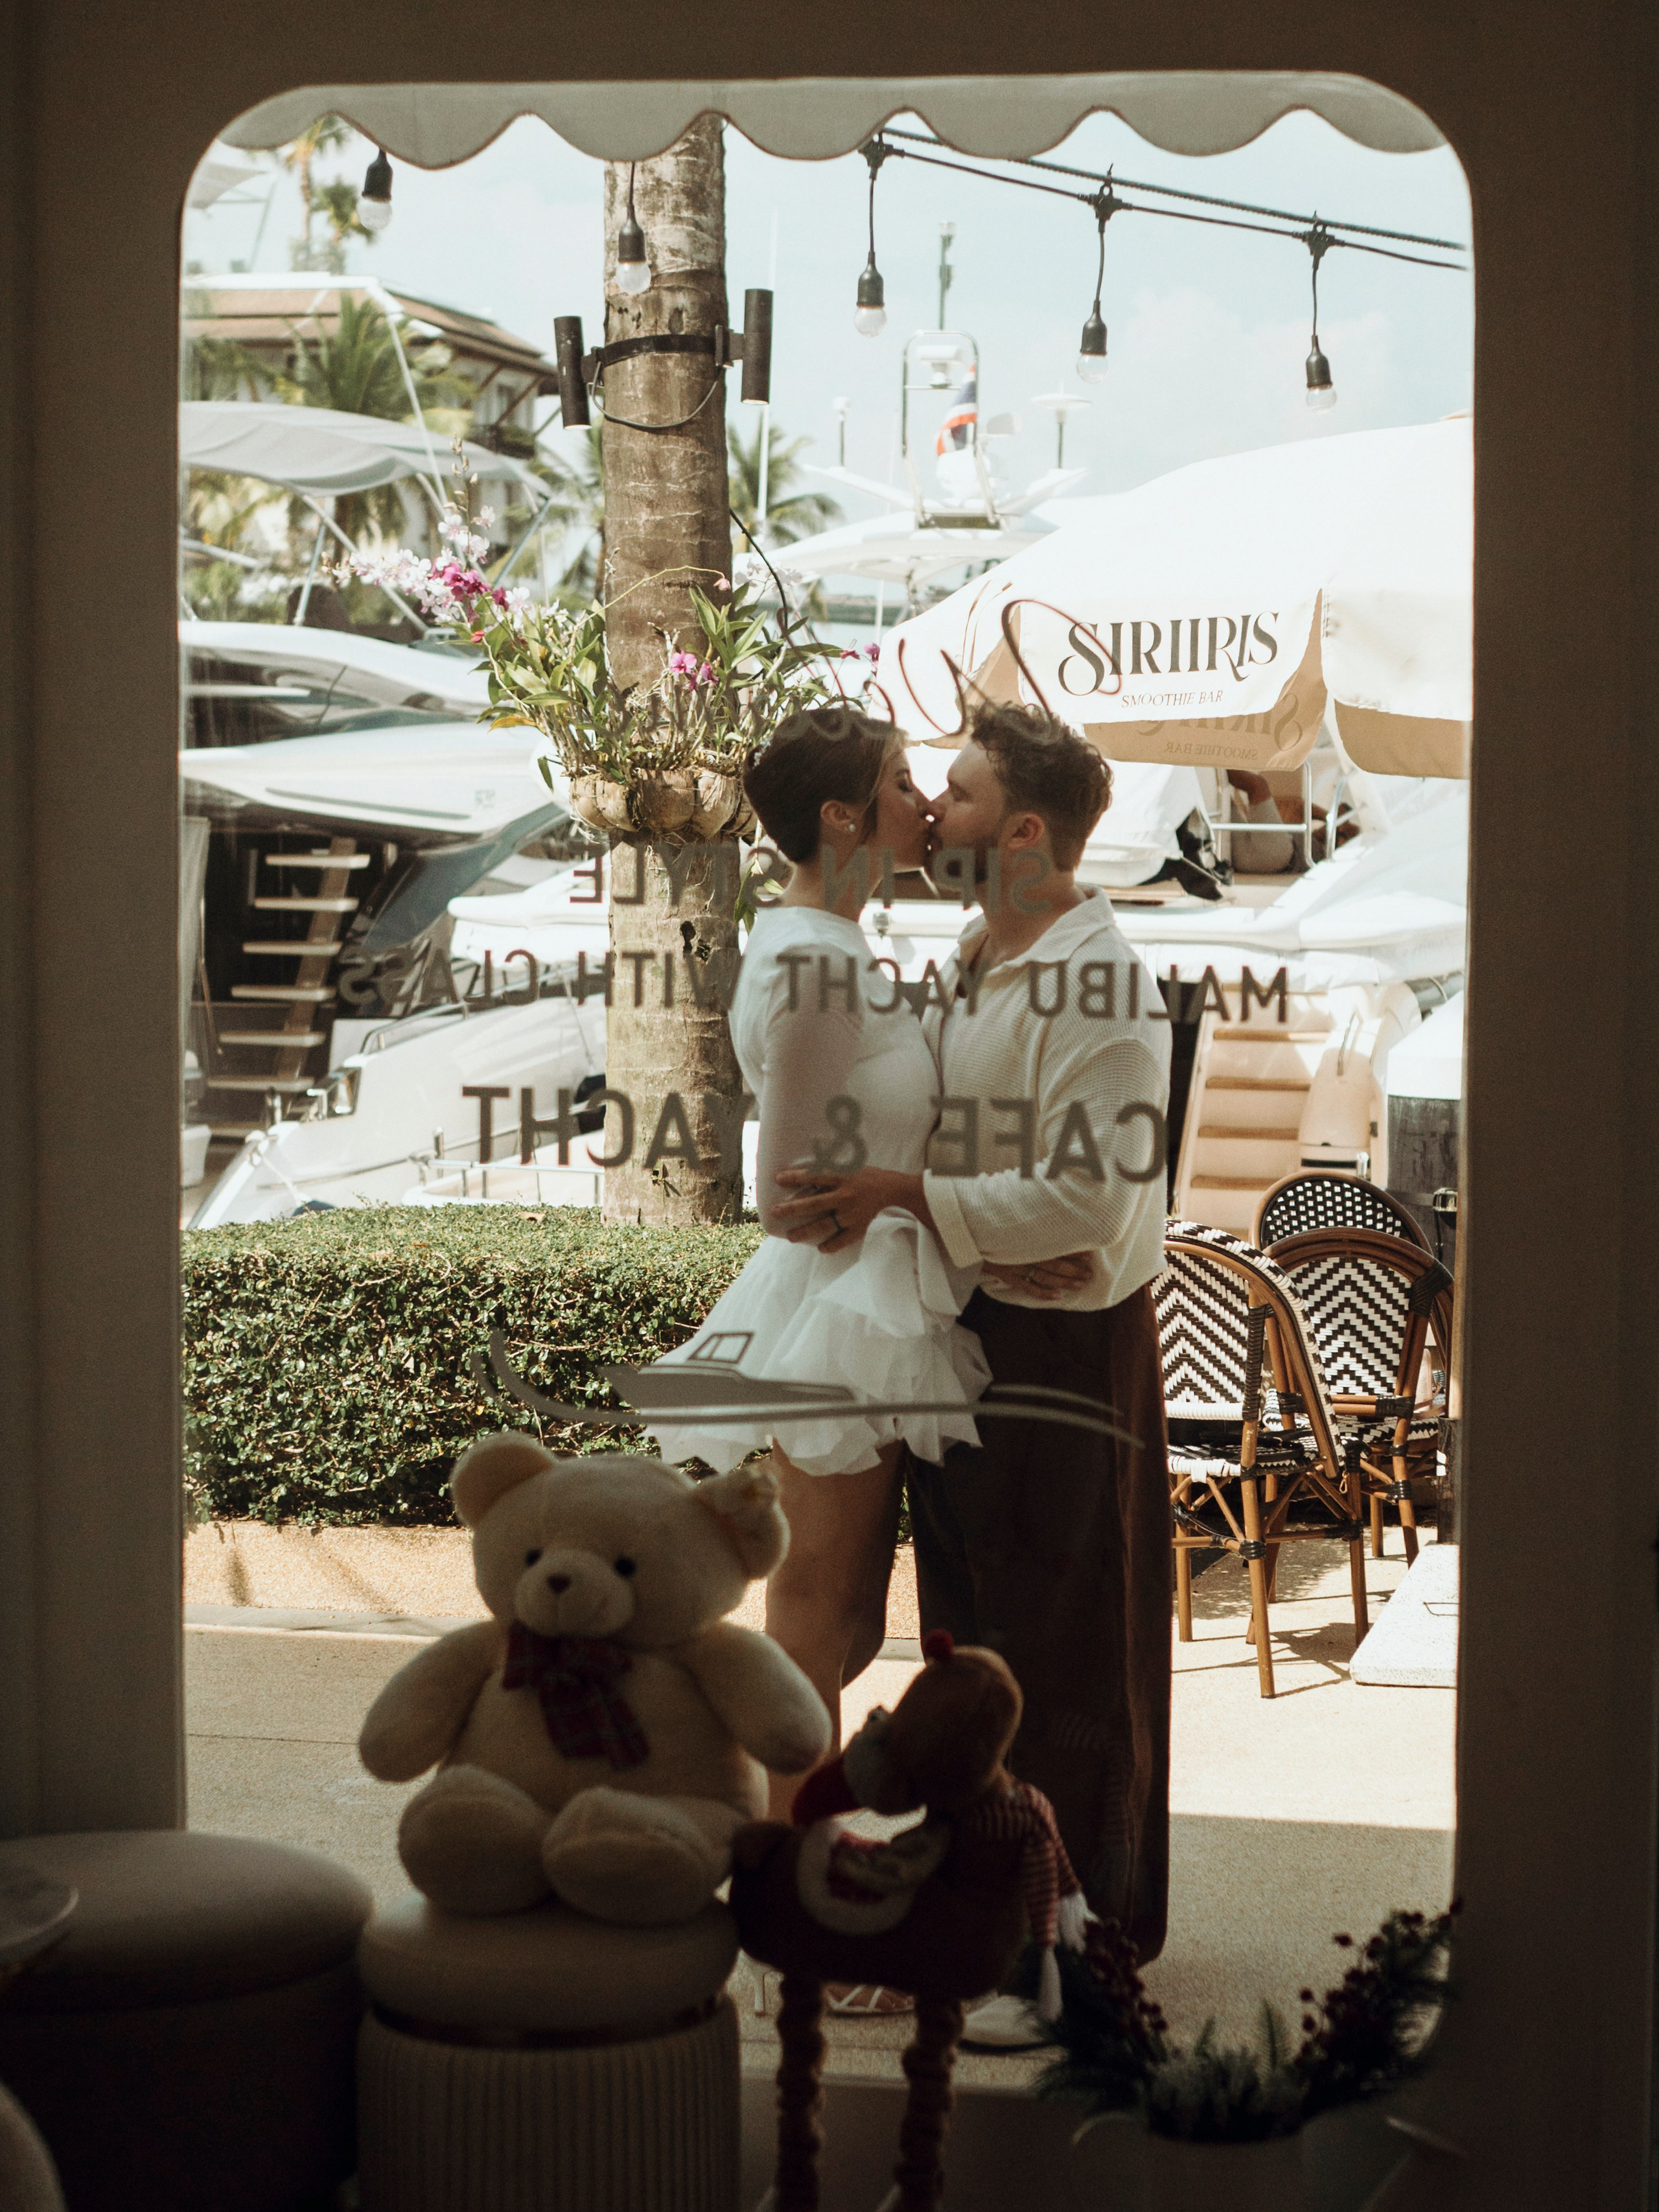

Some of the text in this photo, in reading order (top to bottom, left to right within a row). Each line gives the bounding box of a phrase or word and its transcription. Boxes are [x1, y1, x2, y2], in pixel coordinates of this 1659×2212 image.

[1058, 611, 1279, 696] SIRIIRIS
[1121, 690, 1224, 708] SMOOTHIE BAR
